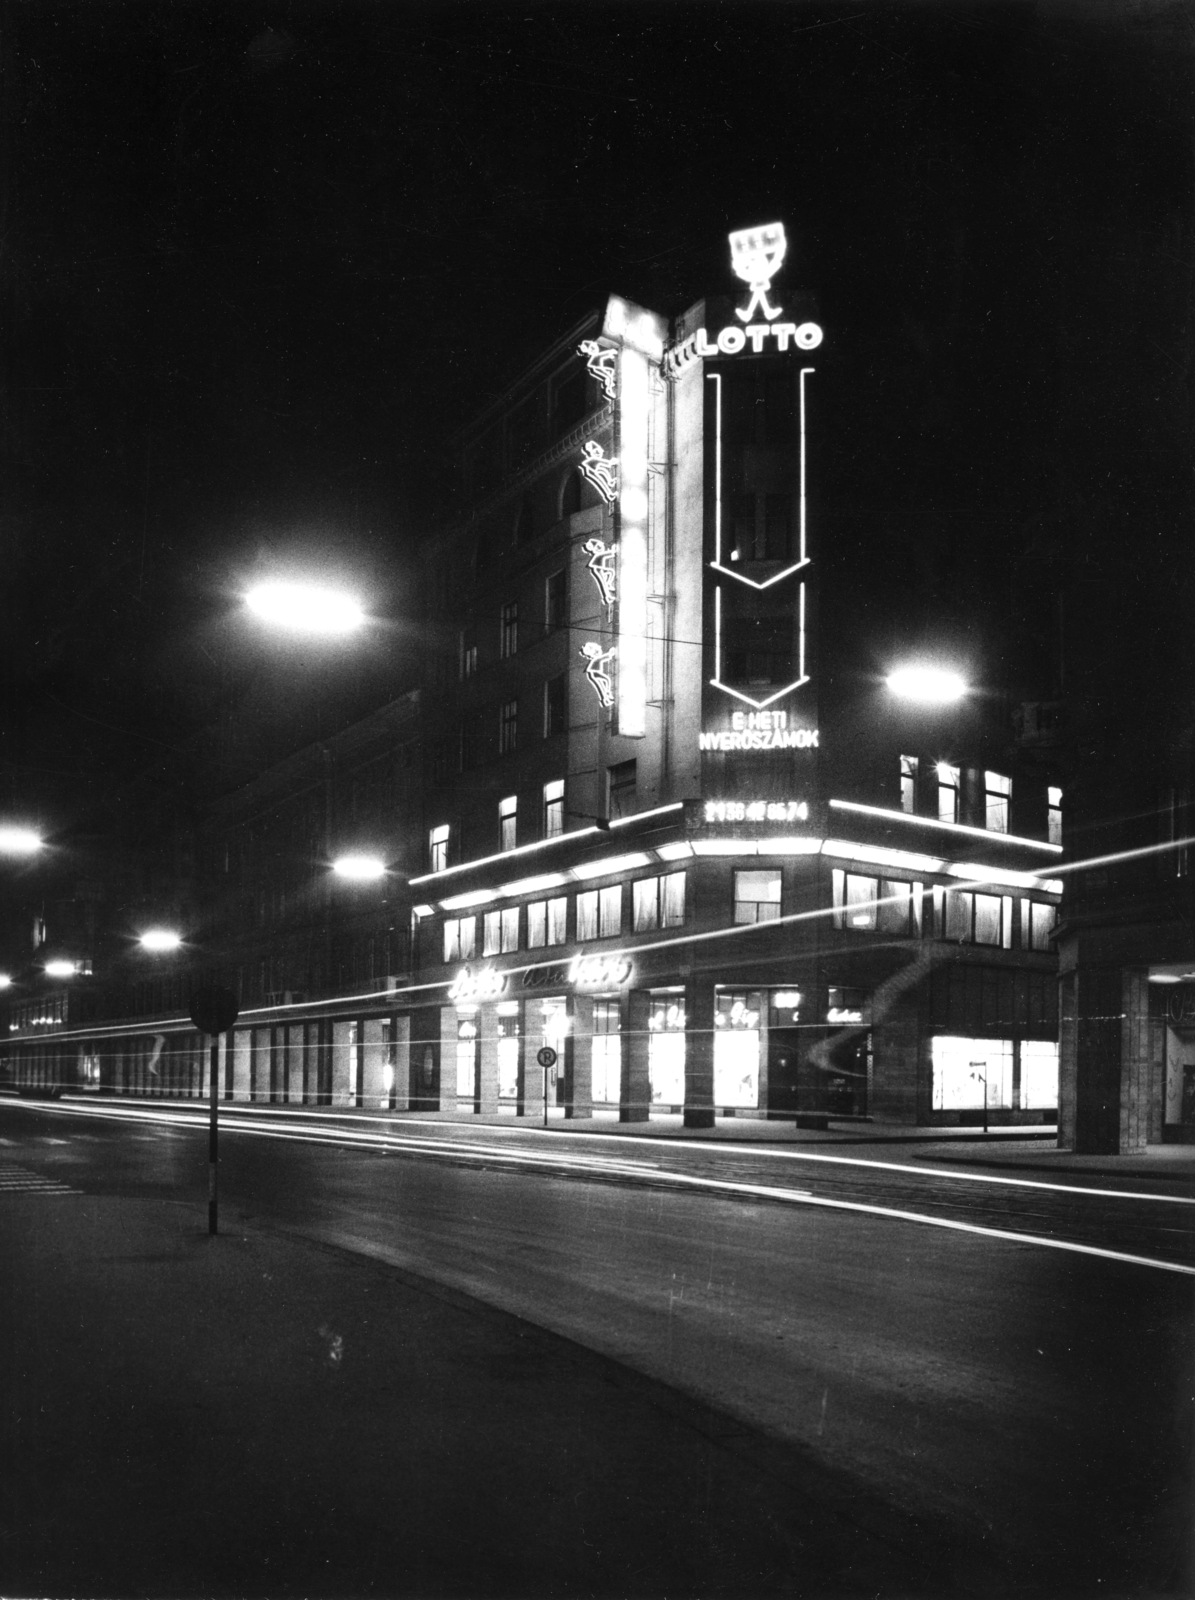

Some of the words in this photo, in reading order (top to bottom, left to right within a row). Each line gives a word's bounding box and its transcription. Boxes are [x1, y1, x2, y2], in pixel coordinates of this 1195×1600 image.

[696, 322, 823, 356] LOTTO
[732, 711, 745, 730] E
[748, 710, 787, 730] HETI
